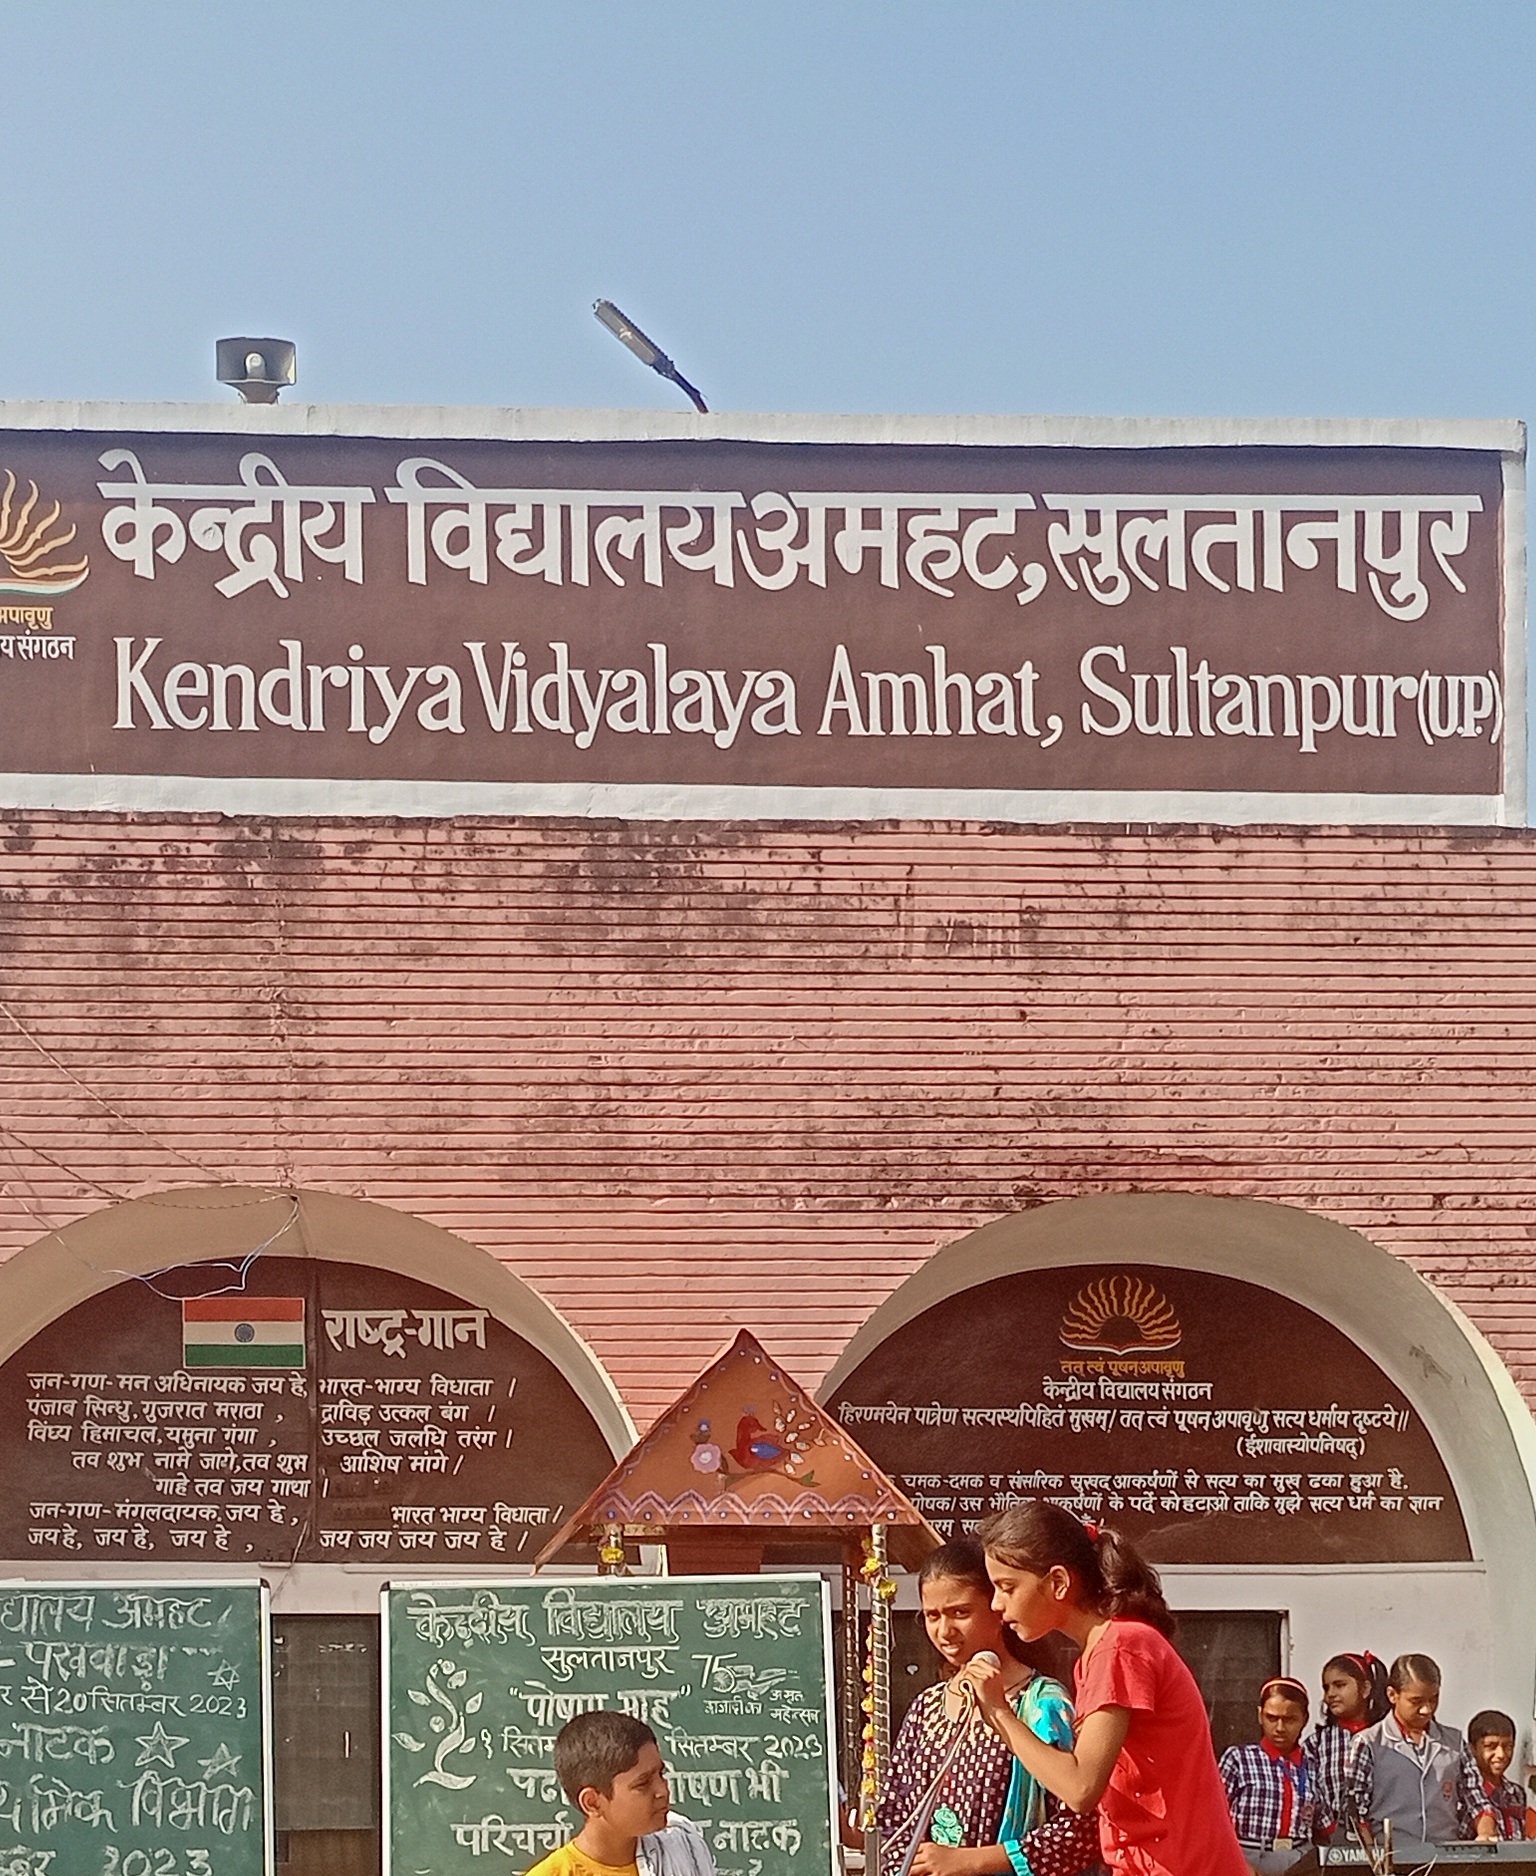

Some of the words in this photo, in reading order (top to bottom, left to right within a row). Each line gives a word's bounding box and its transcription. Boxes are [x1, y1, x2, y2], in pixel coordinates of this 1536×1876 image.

[96, 448, 375, 600] केन्द्रीय
[386, 454, 745, 589] विद्यालय
[1042, 493, 1482, 621] सुलतानपुर
[17, 629, 76, 660] संगठन
[113, 636, 465, 744] Kendriya
[464, 640, 801, 749] Vidyalaya
[818, 644, 1064, 748] Amhat,
[154, 1370, 246, 1393] अधिनायक
[251, 1376, 284, 1394] जय
[430, 1373, 493, 1397] विधाता
[1043, 1376, 1096, 1402] केन्द्रीय
[1098, 1376, 1160, 1400] विद्यालय
[1161, 1378, 1213, 1400] संगठन
[26, 1393, 78, 1417] पंजाब
[141, 1400, 207, 1423] गुजरात
[378, 1404, 432, 1424] उत्कल
[439, 1400, 469, 1422] बंग
[1120, 1409, 1145, 1432] तत्
[1147, 1406, 1170, 1428] त्वं
[1272, 1410, 1307, 1430] सत्य
[1308, 1403, 1350, 1429] धर्माय
[165, 1425, 217, 1449] यमुना
[222, 1422, 259, 1445] गंगा
[389, 1425, 448, 1448] जलधि
[456, 1426, 497, 1450] तरंग
[71, 1451, 101, 1469] तव
[106, 1451, 144, 1473] शुभ
[242, 1453, 273, 1470] तव
[276, 1453, 308, 1475] शुभ
[340, 1449, 402, 1474] आशिष
[408, 1449, 449, 1473] मांगे
[154, 1472, 191, 1496] गाहे
[194, 1478, 223, 1496] तव
[230, 1478, 264, 1497] जय
[270, 1478, 311, 1498] गाथा
[988, 1474, 1004, 1489] व
[1069, 1474, 1112, 1493] सुखद
[1183, 1468, 1200, 1489] से
[1205, 1474, 1239, 1490] सत्य
[1243, 1474, 1266, 1489] का
[1270, 1474, 1302, 1493] मुख
[1307, 1474, 1344, 1489] ढका
[1349, 1474, 1383, 1493] हुआ
[225, 1503, 262, 1522] जय
[391, 1505, 436, 1525] भारत
[440, 1506, 487, 1525] भाग्य
[492, 1501, 550, 1526] विधाता
[959, 1497, 985, 1512] उस
[1109, 1491, 1125, 1511] के
[1160, 1490, 1180, 1512] को
[1182, 1490, 1230, 1513] हटाओ
[1233, 1490, 1270, 1512] ताकि
[1272, 1490, 1303, 1515] मुझे
[1307, 1496, 1344, 1512] सत्य
[1346, 1491, 1377, 1512] धर्म
[1379, 1496, 1404, 1512] का
[1408, 1496, 1444, 1515] ज्ञान
[28, 1527, 61, 1546] जय
[93, 1528, 128, 1547] जय
[169, 1528, 207, 1548] जय
[319, 1529, 354, 1548] जय
[358, 1530, 392, 1549] जय
[398, 1530, 437, 1549] जय
[444, 1530, 482, 1549] जय
[488, 1525, 507, 1551] हे
[541, 1587, 685, 1644] विद्यालय
[540, 1646, 680, 1682] सुलतानपुर
[691, 1653, 738, 1693] 75
[20, 1675, 54, 1715] से
[188, 1694, 248, 1720] 2023
[664, 1725, 761, 1766] सितम्बर
[763, 1733, 824, 1760] 2023
[744, 1759, 790, 1805] भी
[713, 1818, 802, 1857] नाटक
